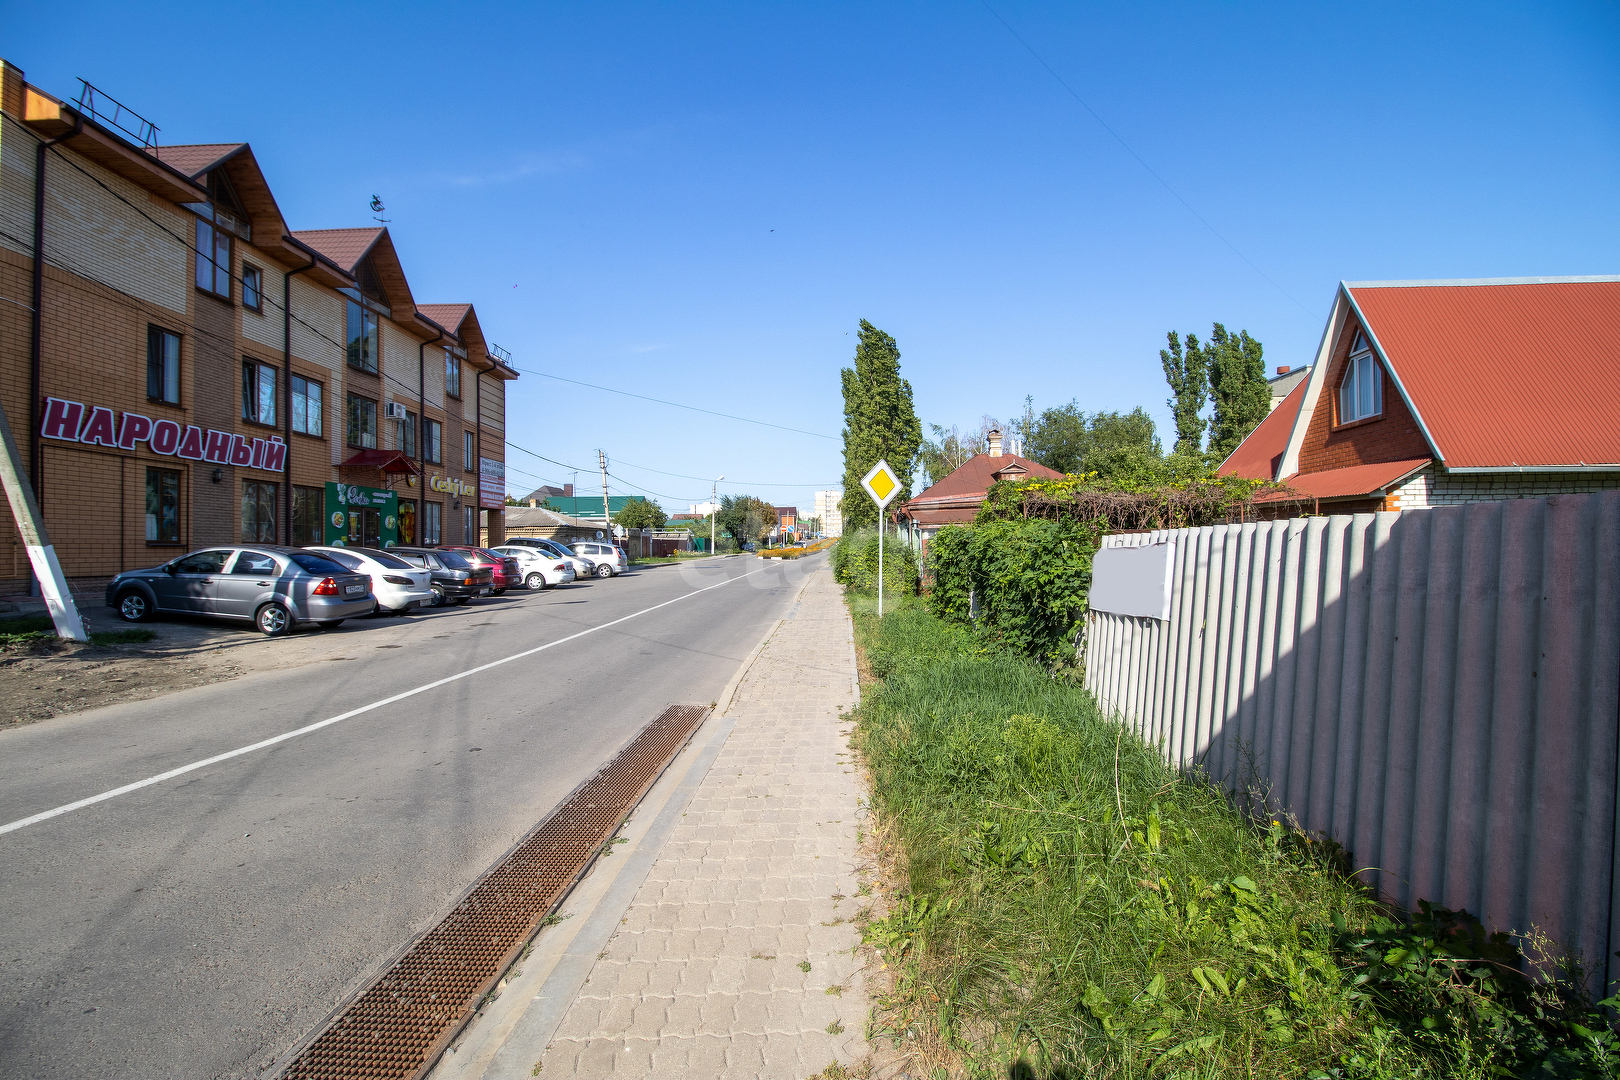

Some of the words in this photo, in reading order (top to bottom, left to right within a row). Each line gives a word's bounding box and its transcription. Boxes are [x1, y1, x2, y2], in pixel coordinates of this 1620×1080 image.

[41, 397, 287, 472] НАРОДНЫЙ
[430, 471, 459, 498] Český
[459, 480, 475, 496] Lev
